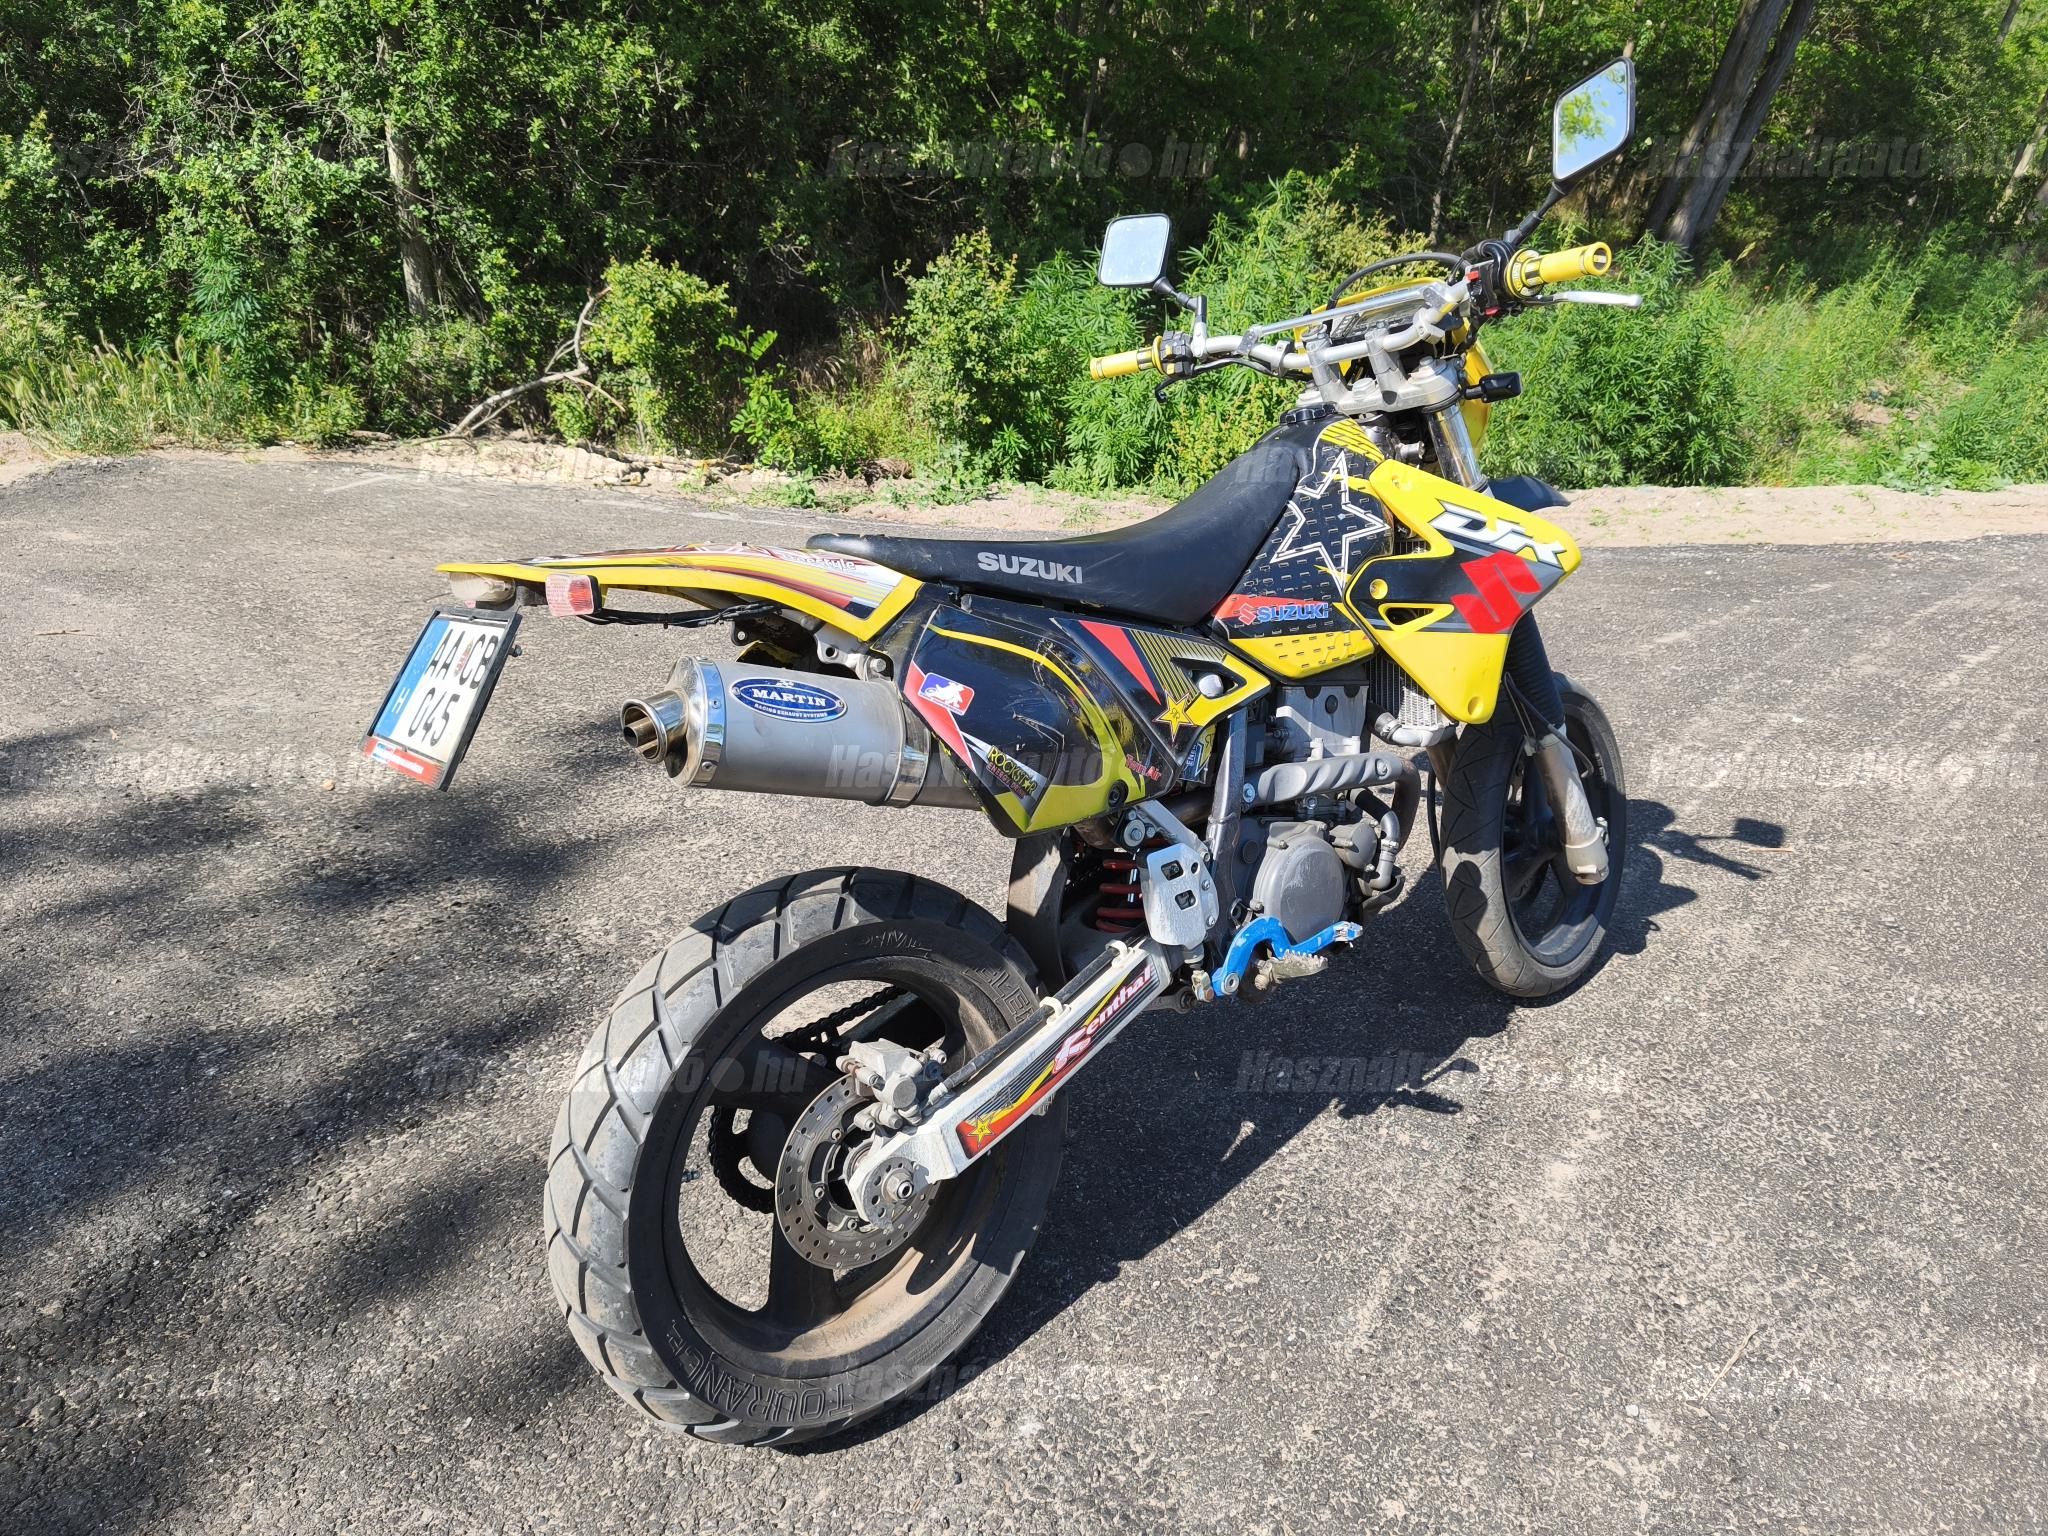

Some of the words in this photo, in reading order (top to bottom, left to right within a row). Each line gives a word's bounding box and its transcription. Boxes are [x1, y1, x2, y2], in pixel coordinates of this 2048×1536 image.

[977, 551, 1083, 584] SUZUKI
[1257, 602, 1329, 622] SUZUKI
[752, 688, 826, 707] MARTIN
[407, 687, 461, 747] 045
[754, 703, 777, 714] RACING
[777, 709, 803, 718] EXHAUST
[985, 762, 1012, 787] ENERGY
